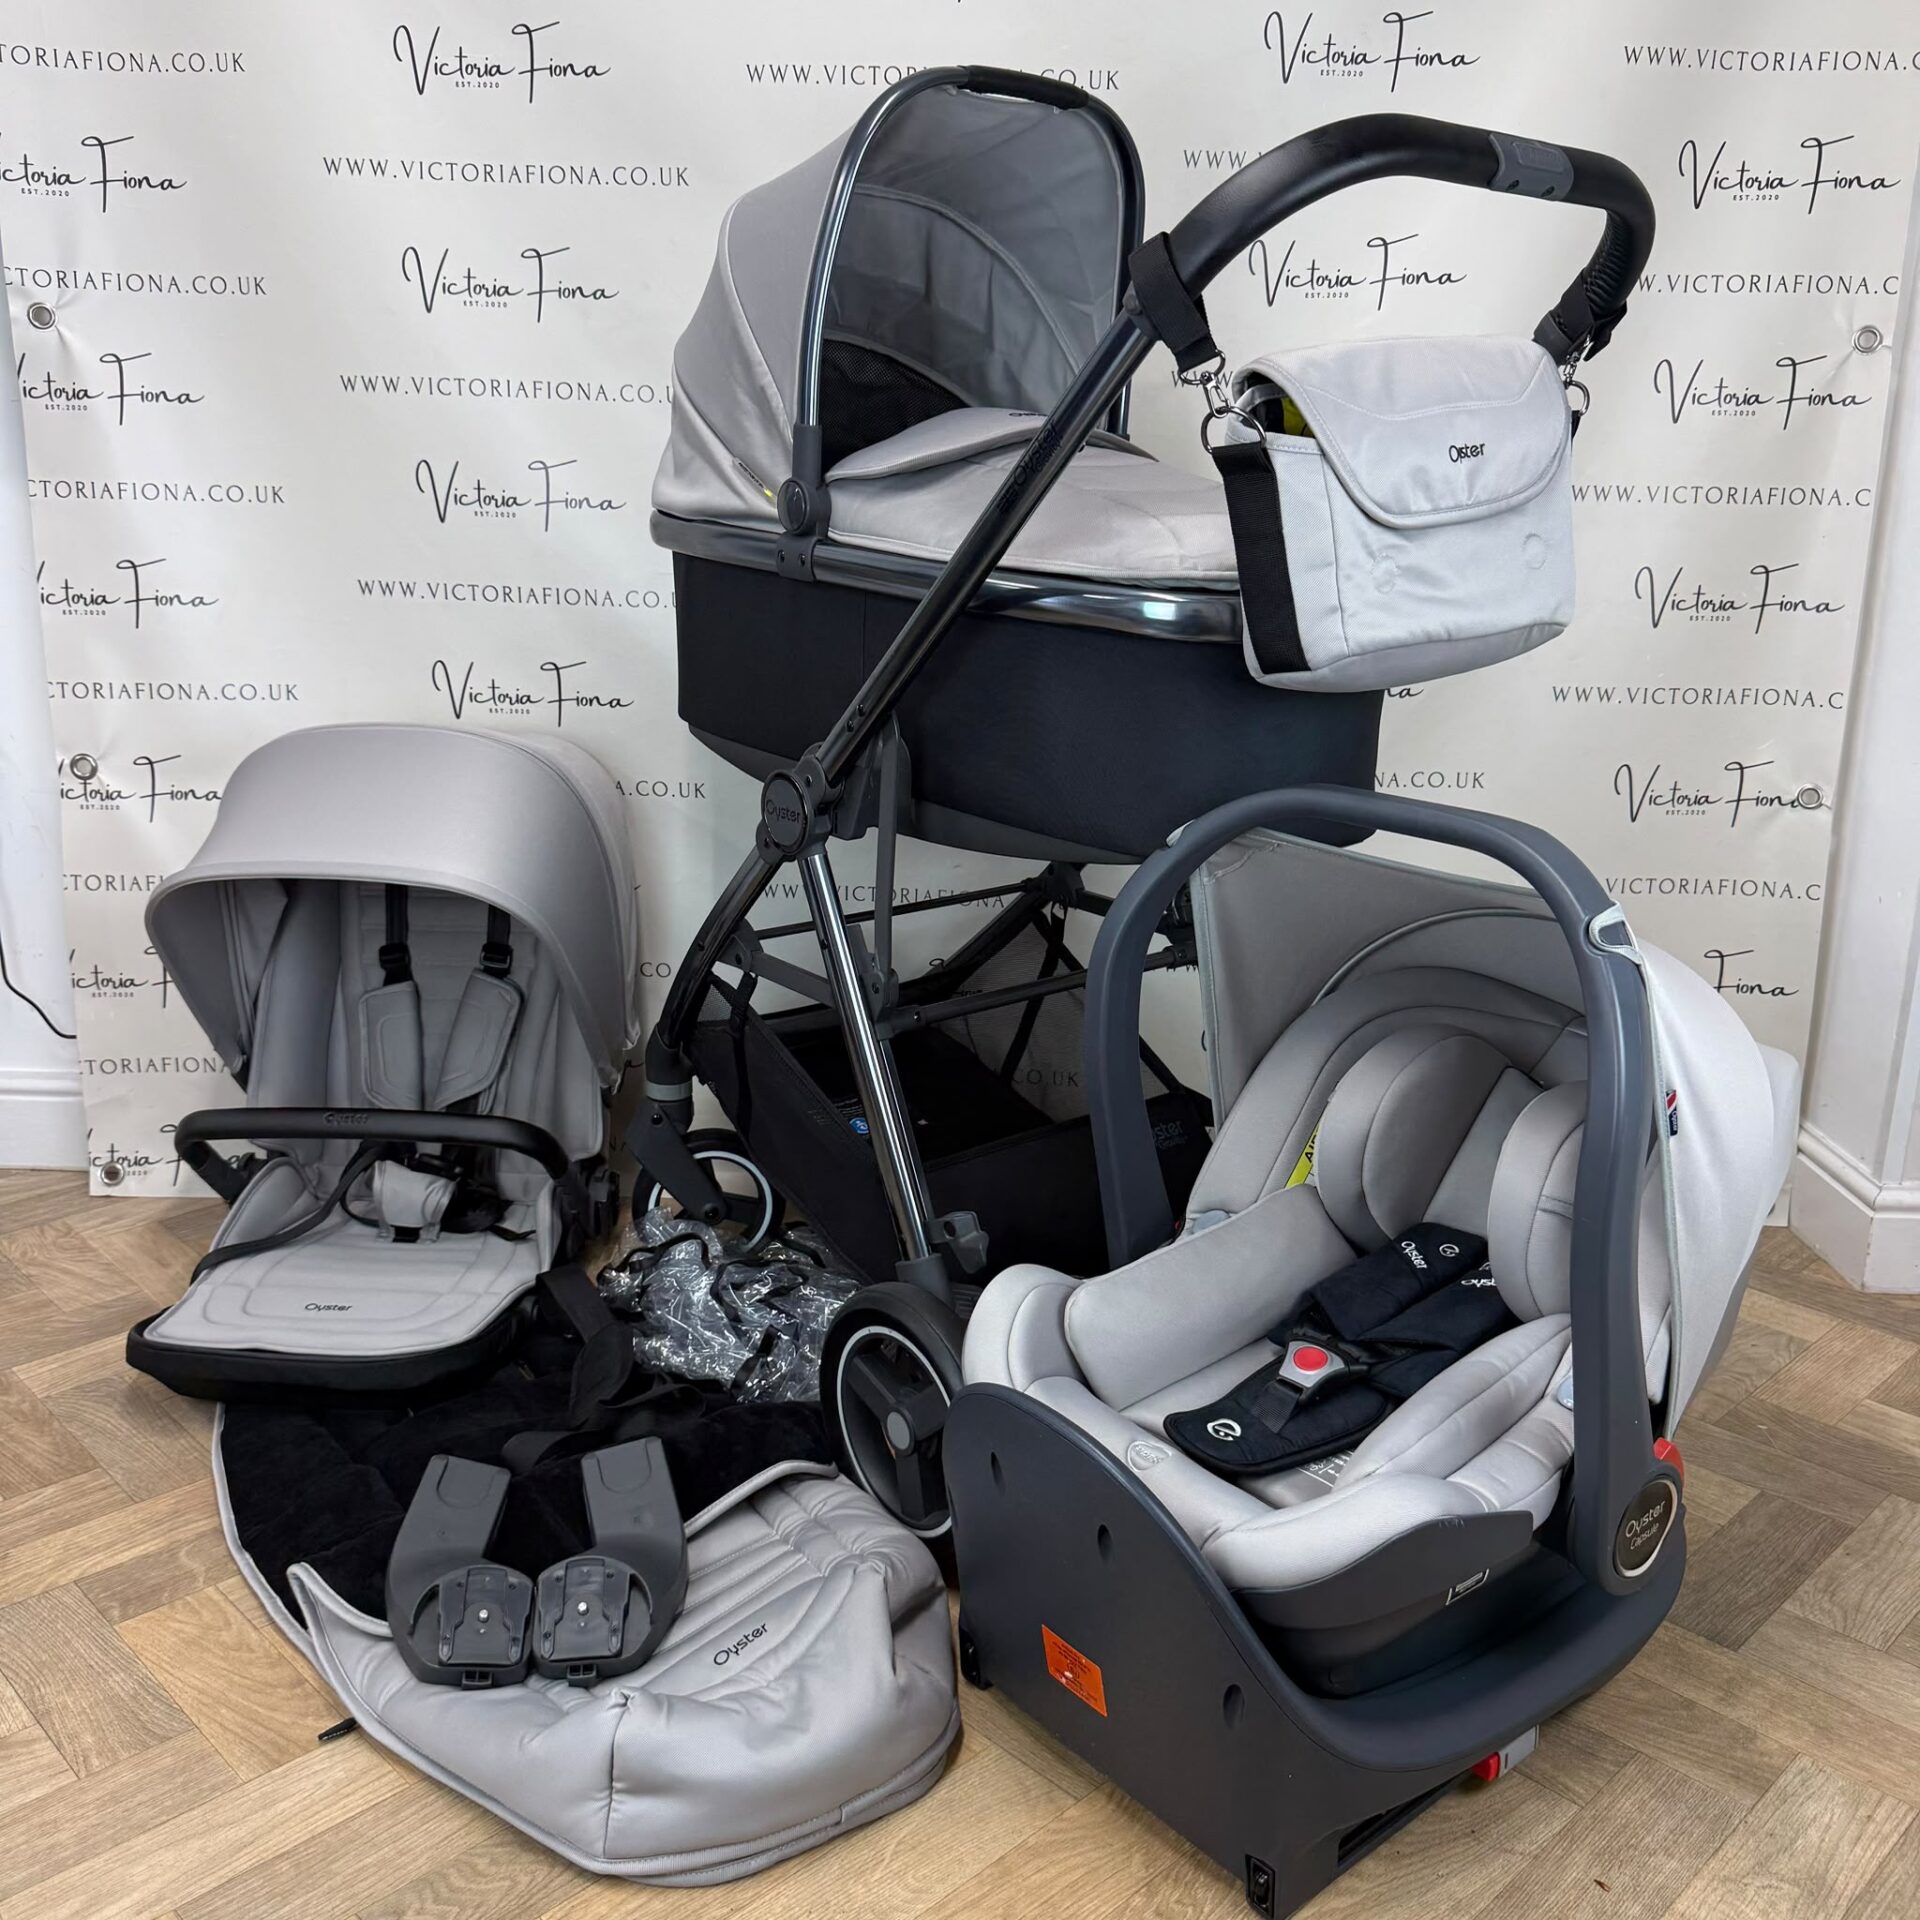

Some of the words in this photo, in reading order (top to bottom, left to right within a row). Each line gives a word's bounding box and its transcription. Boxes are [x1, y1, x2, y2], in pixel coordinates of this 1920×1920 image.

[393, 24, 516, 96] Victoria
[511, 21, 611, 104] Fiona
[1264, 11, 1381, 84] Victoria
[1383, 11, 1481, 93] Fiona
[81, 135, 188, 213] Fiona
[322, 157, 690, 188] WWW.VICTORIAFIONA.CO.UK
[1679, 139, 1799, 210] Victoria
[1801, 135, 1901, 215] Fiona
[402, 246, 524, 314] Victoria
[520, 246, 620, 323] Fiona
[1248, 240, 1366, 307] Victoria
[1367, 234, 1467, 311] Fiona
[100, 352, 205, 426] Fiona
[1654, 359, 1774, 425] Victoria
[1776, 355, 1872, 431] Fiona
[415, 459, 532, 523] Victoria
[528, 459, 627, 532] Fiona
[37, 560, 121, 608] ictoria
[116, 558, 219, 629] Fiona
[1634, 566, 1749, 629] Victoria
[1749, 563, 1845, 634] Fiona
[432, 660, 544, 720] Victoria
[540, 661, 634, 728] Fiona
[1552, 685, 1843, 710] WWW.VICTORIAFIONA.C
[58, 758, 136, 803] ictoria
[1614, 764, 1723, 824] Victoria
[69, 949, 149, 990] ictoria
[1400, 1240, 1428, 1269] Oyster
[304, 1302, 352, 1312] Oyster
[1625, 1500, 1666, 1538] Oyster
[1630, 1522, 1660, 1550] Capsule
[713, 1622, 767, 1666] Oyster
